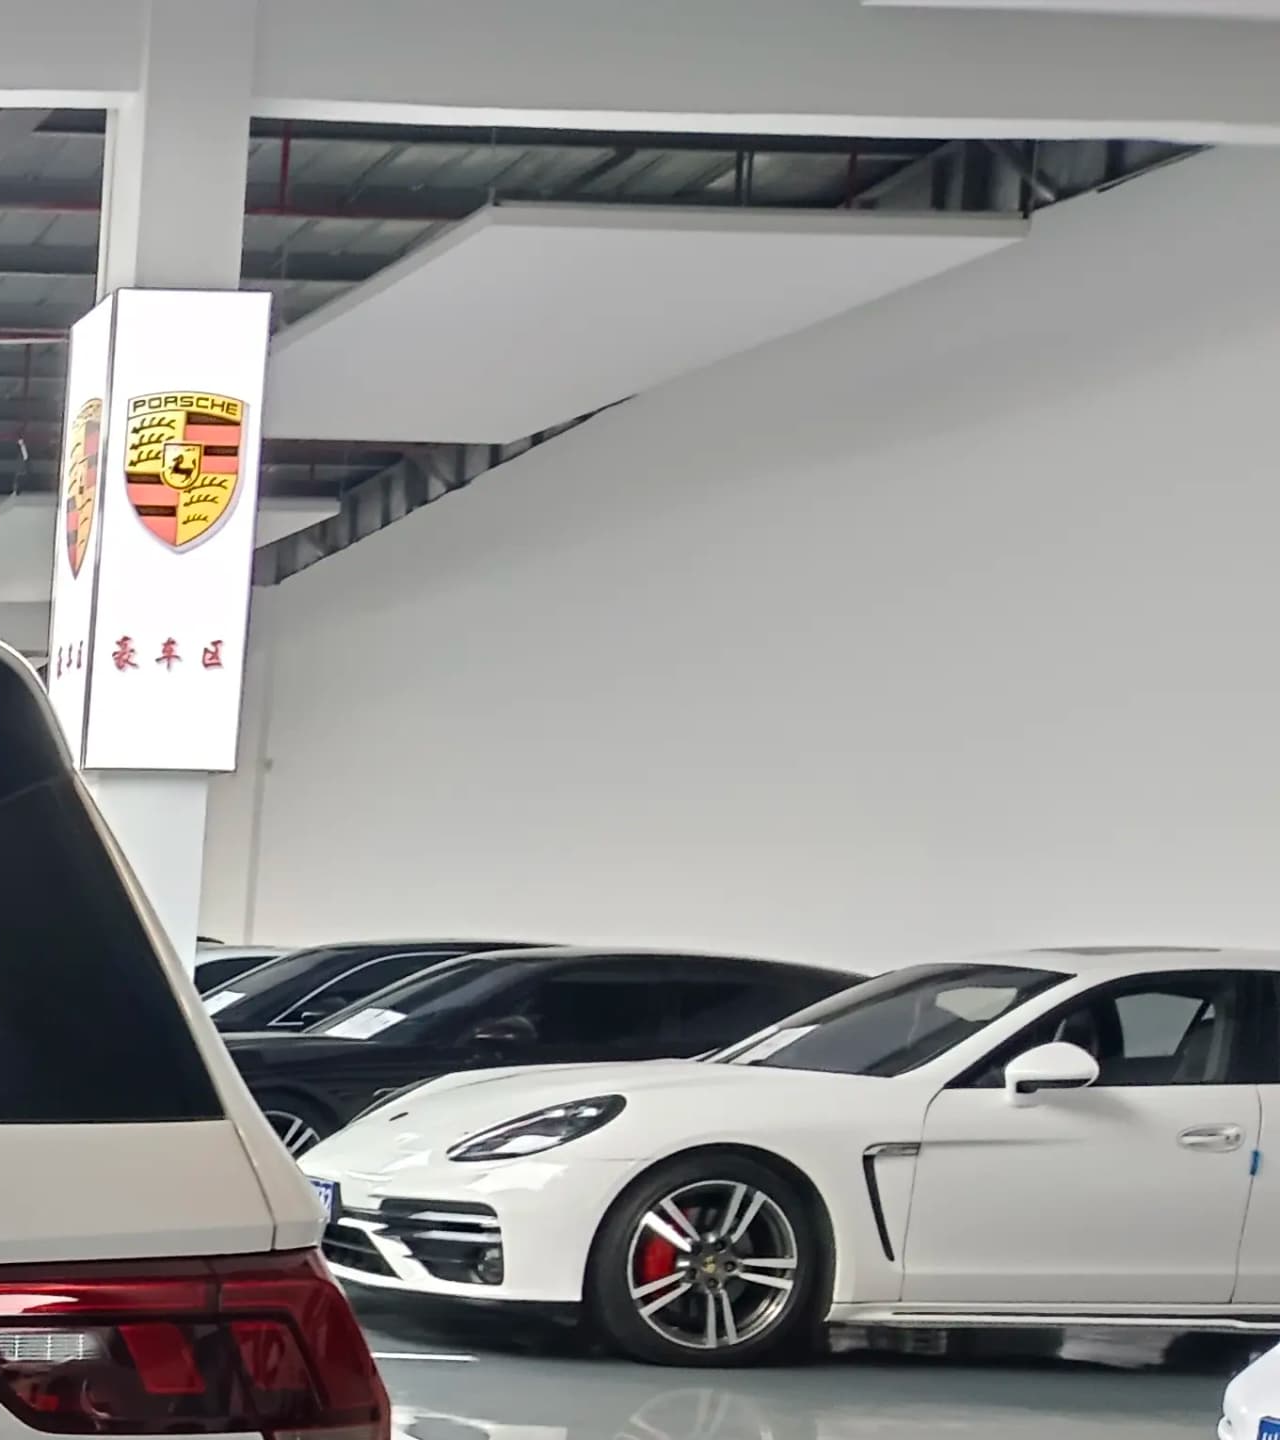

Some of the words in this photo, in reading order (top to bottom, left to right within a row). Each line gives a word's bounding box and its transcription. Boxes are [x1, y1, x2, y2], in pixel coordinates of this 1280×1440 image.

[132, 395, 239, 416] PORSCHE
[111, 635, 223, 673] 豪车区
